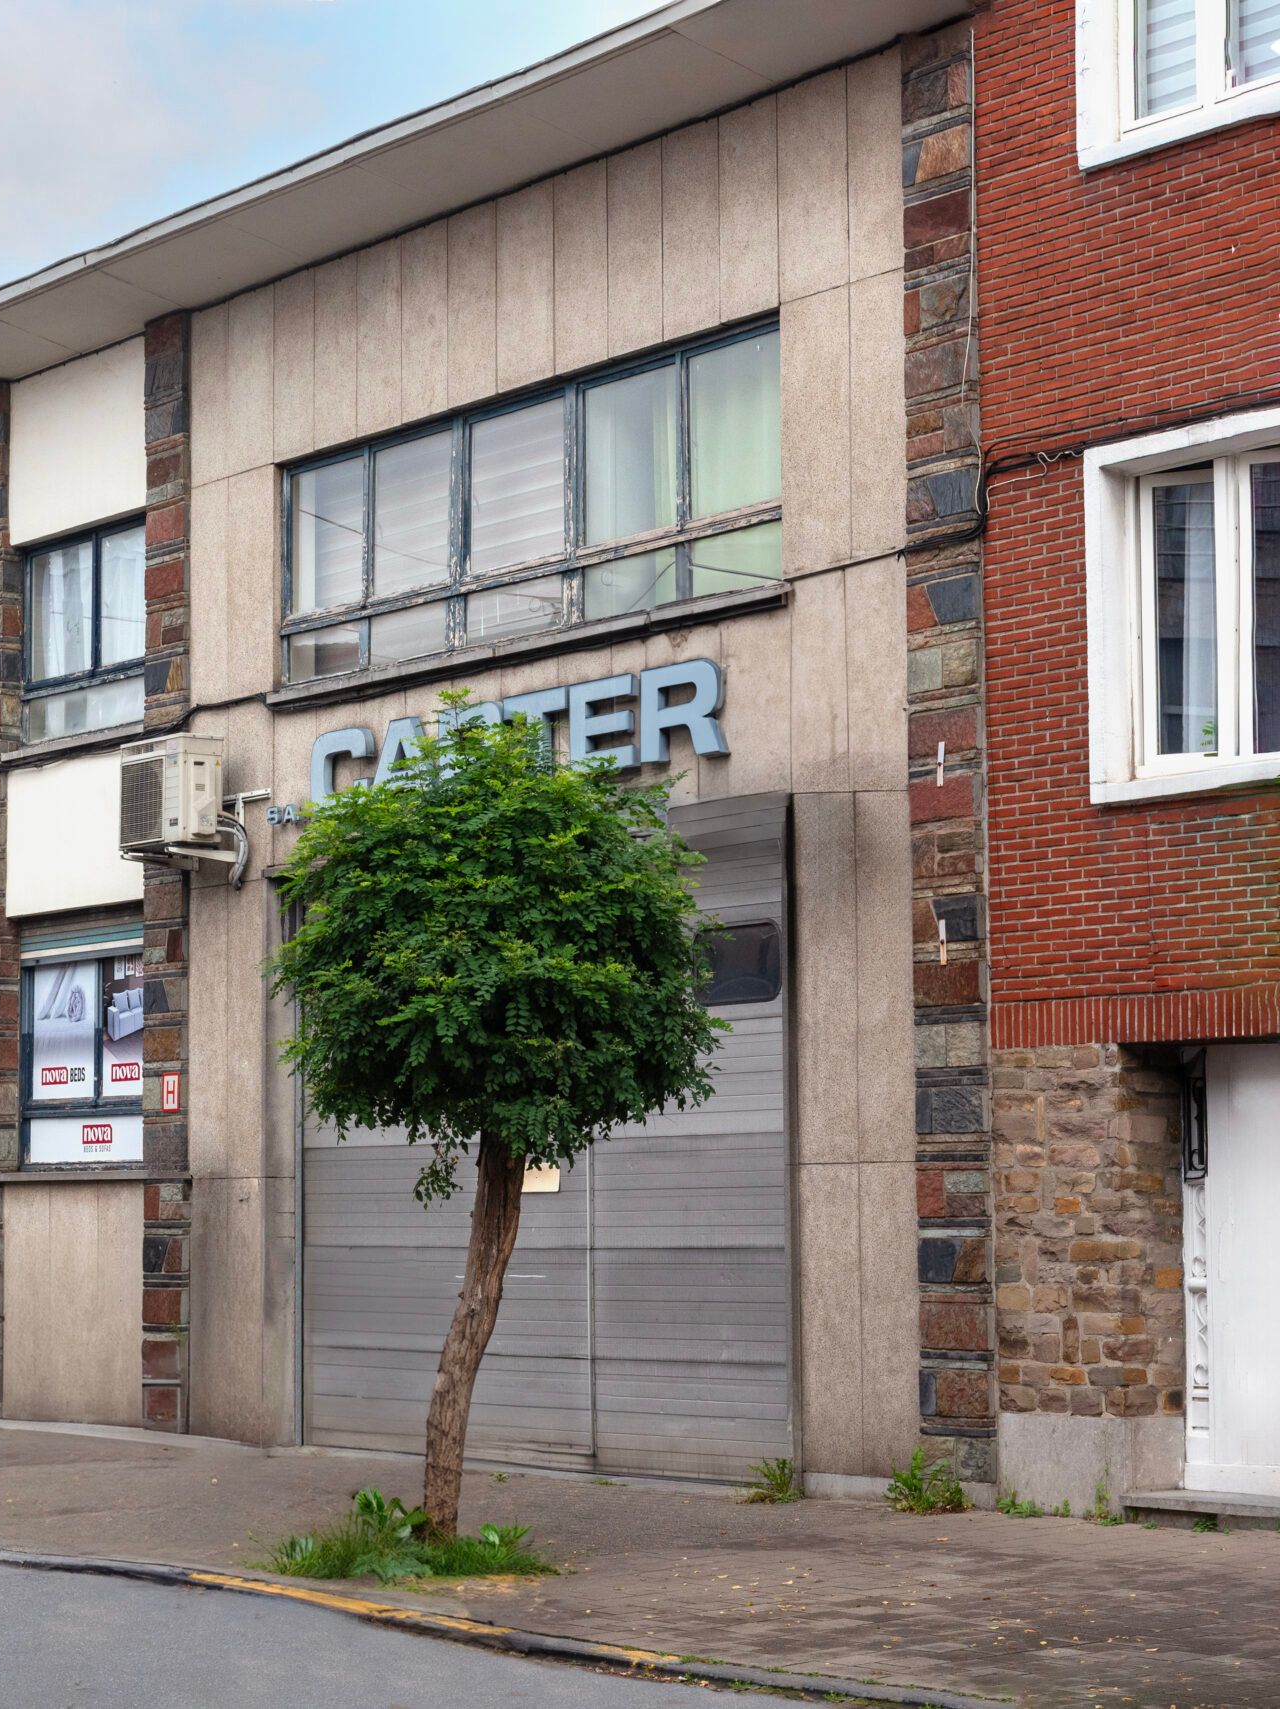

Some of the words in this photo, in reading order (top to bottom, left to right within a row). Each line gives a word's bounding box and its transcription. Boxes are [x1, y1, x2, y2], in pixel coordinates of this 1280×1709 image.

[43, 1069, 67, 1084] nova
[70, 1067, 86, 1083] BEDS
[112, 1065, 139, 1081] nova
[84, 1126, 112, 1142] nova
